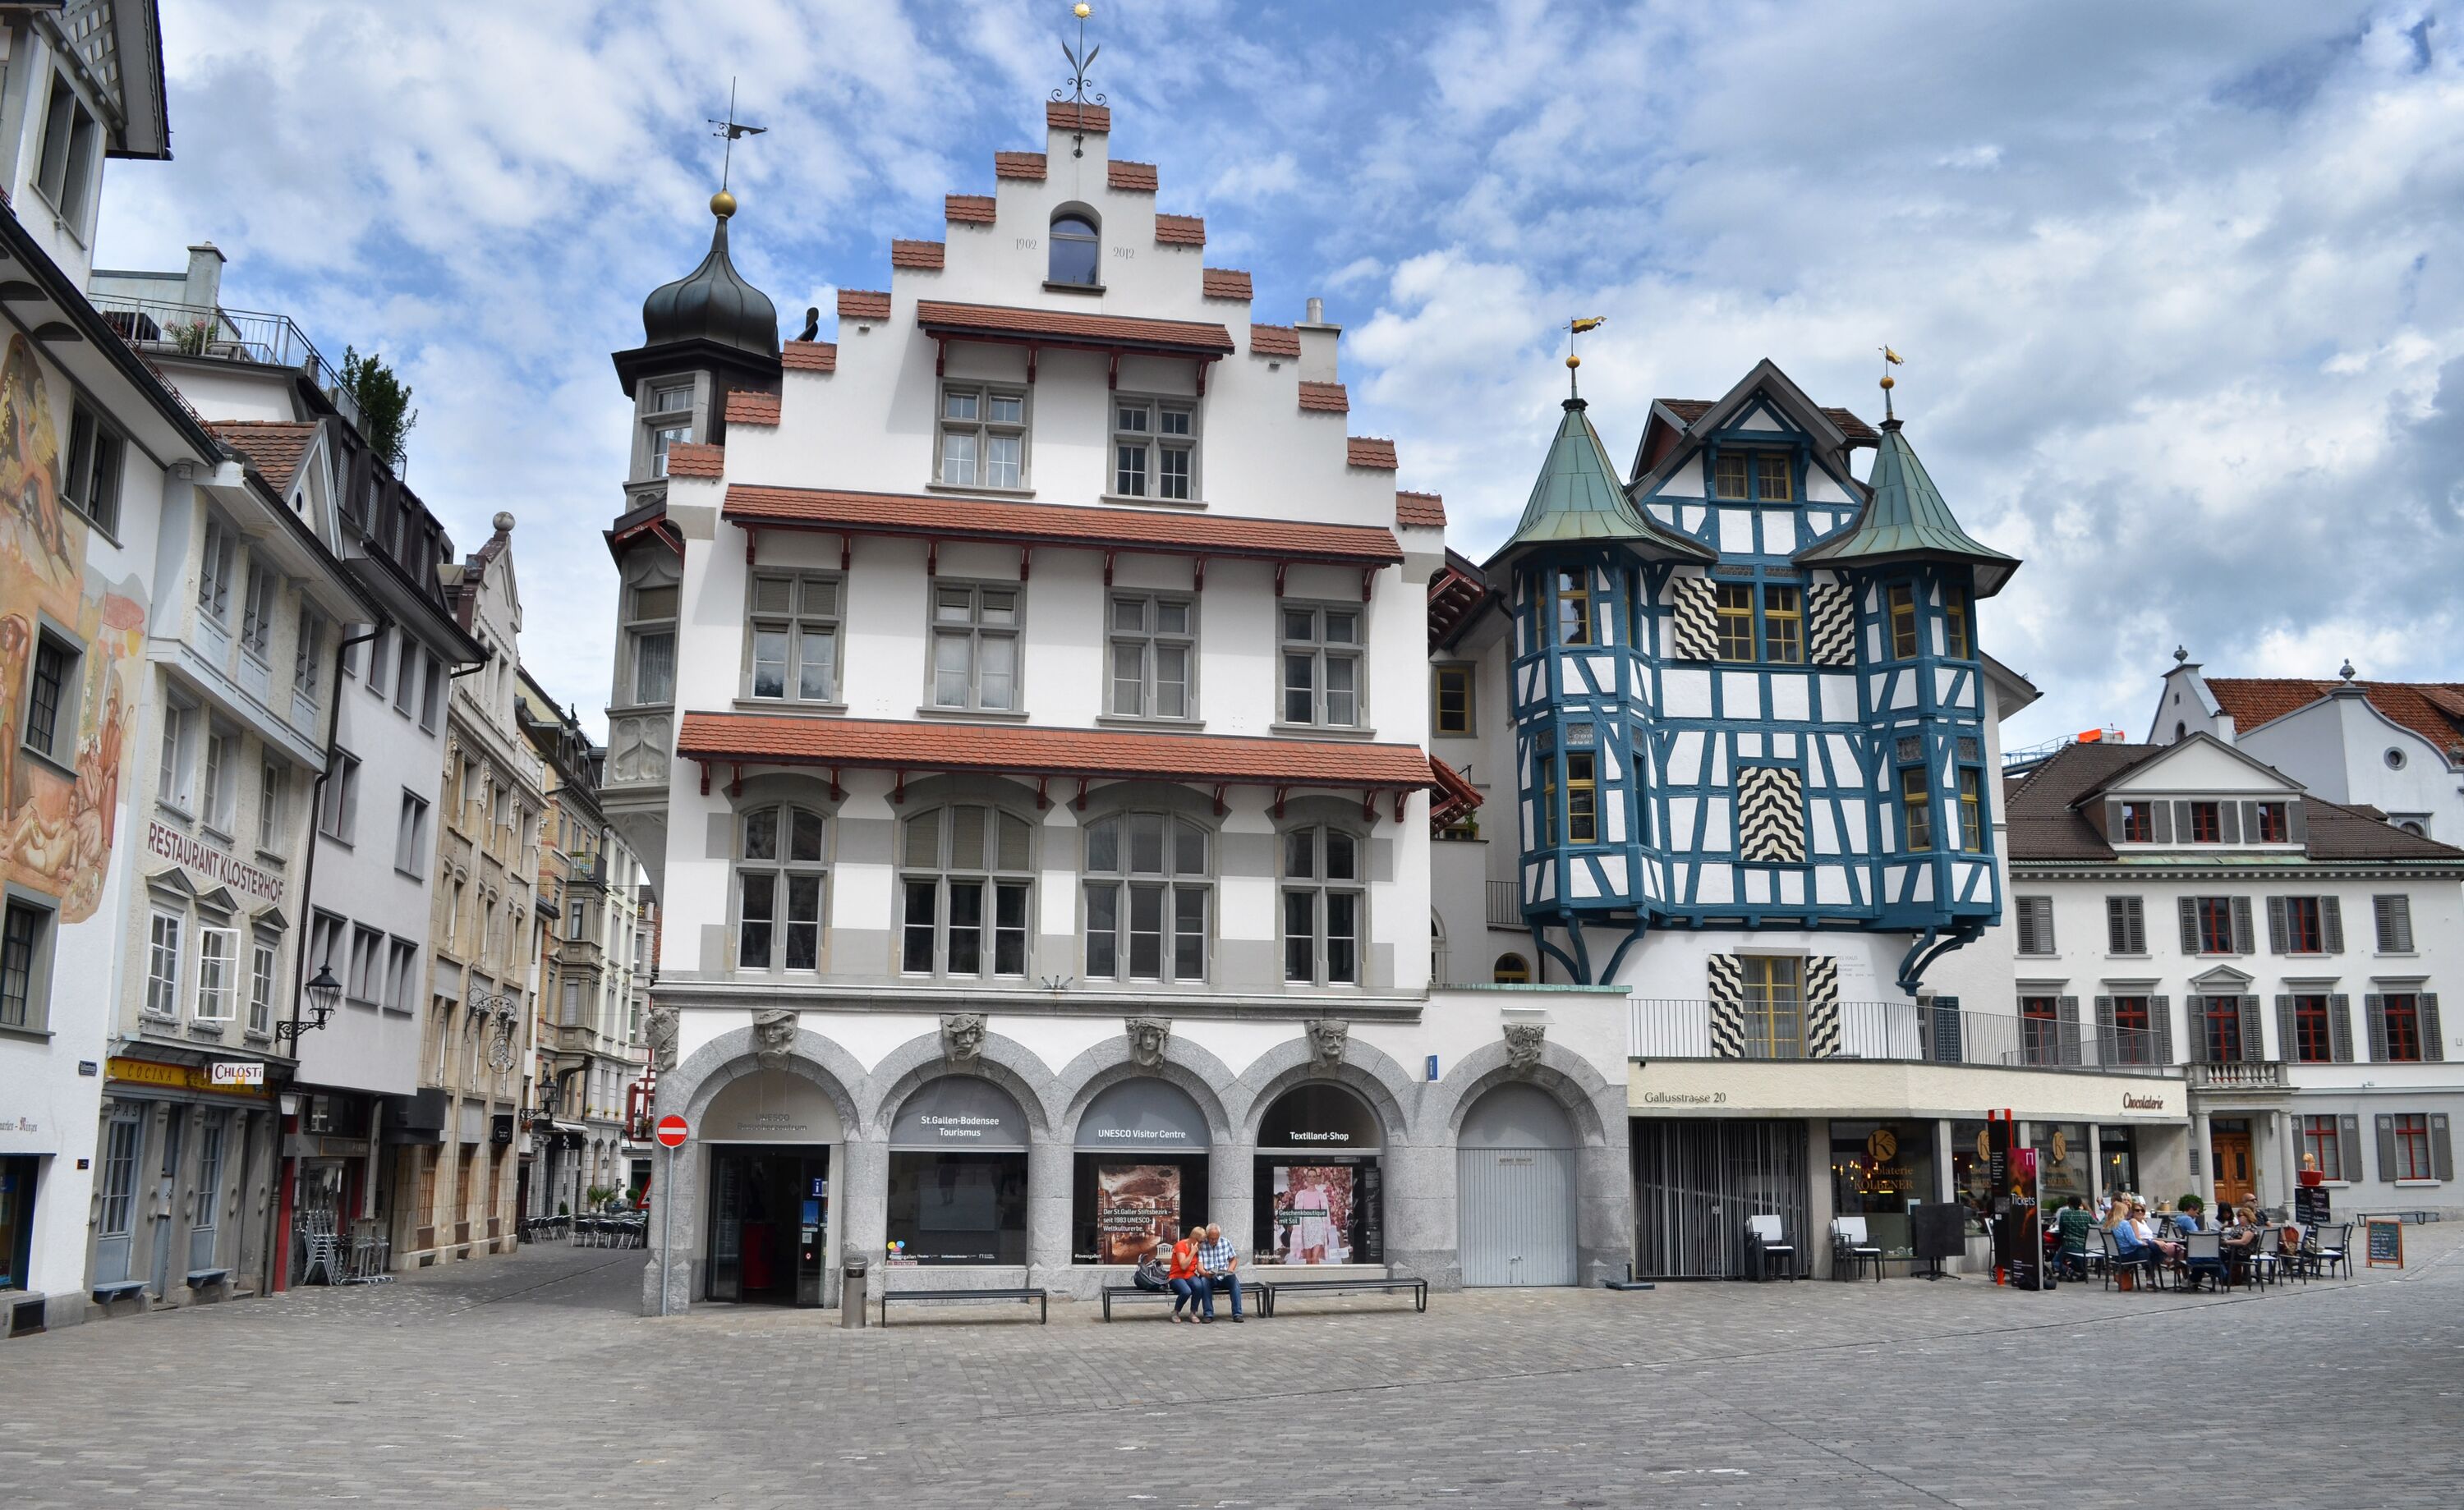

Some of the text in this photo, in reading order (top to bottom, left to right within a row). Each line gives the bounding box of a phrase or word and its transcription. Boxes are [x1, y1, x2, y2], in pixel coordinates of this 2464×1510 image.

[1016, 238, 1037, 250] 1902
[1113, 246, 1134, 259] 2012
[148, 822, 284, 904] RESTAURANT KLOSTERHOF
[127, 1063, 172, 1081] COCINA
[1644, 1092, 1726, 1103] Gallusstrasse 20
[2123, 1092, 2163, 1108] Chocolaterie
[756, 1113, 790, 1122] UNESCO
[921, 1116, 1000, 1125] St.Gallen-Bodensee
[737, 1122, 807, 1131] Besucherzentrum
[939, 1127, 981, 1136] Tourismus
[1098, 1129, 1186, 1139] UNESCO Visitor Centre
[1289, 1131, 1349, 1142] Textilland-Shop
[2011, 1193, 2035, 1206] Tickets
